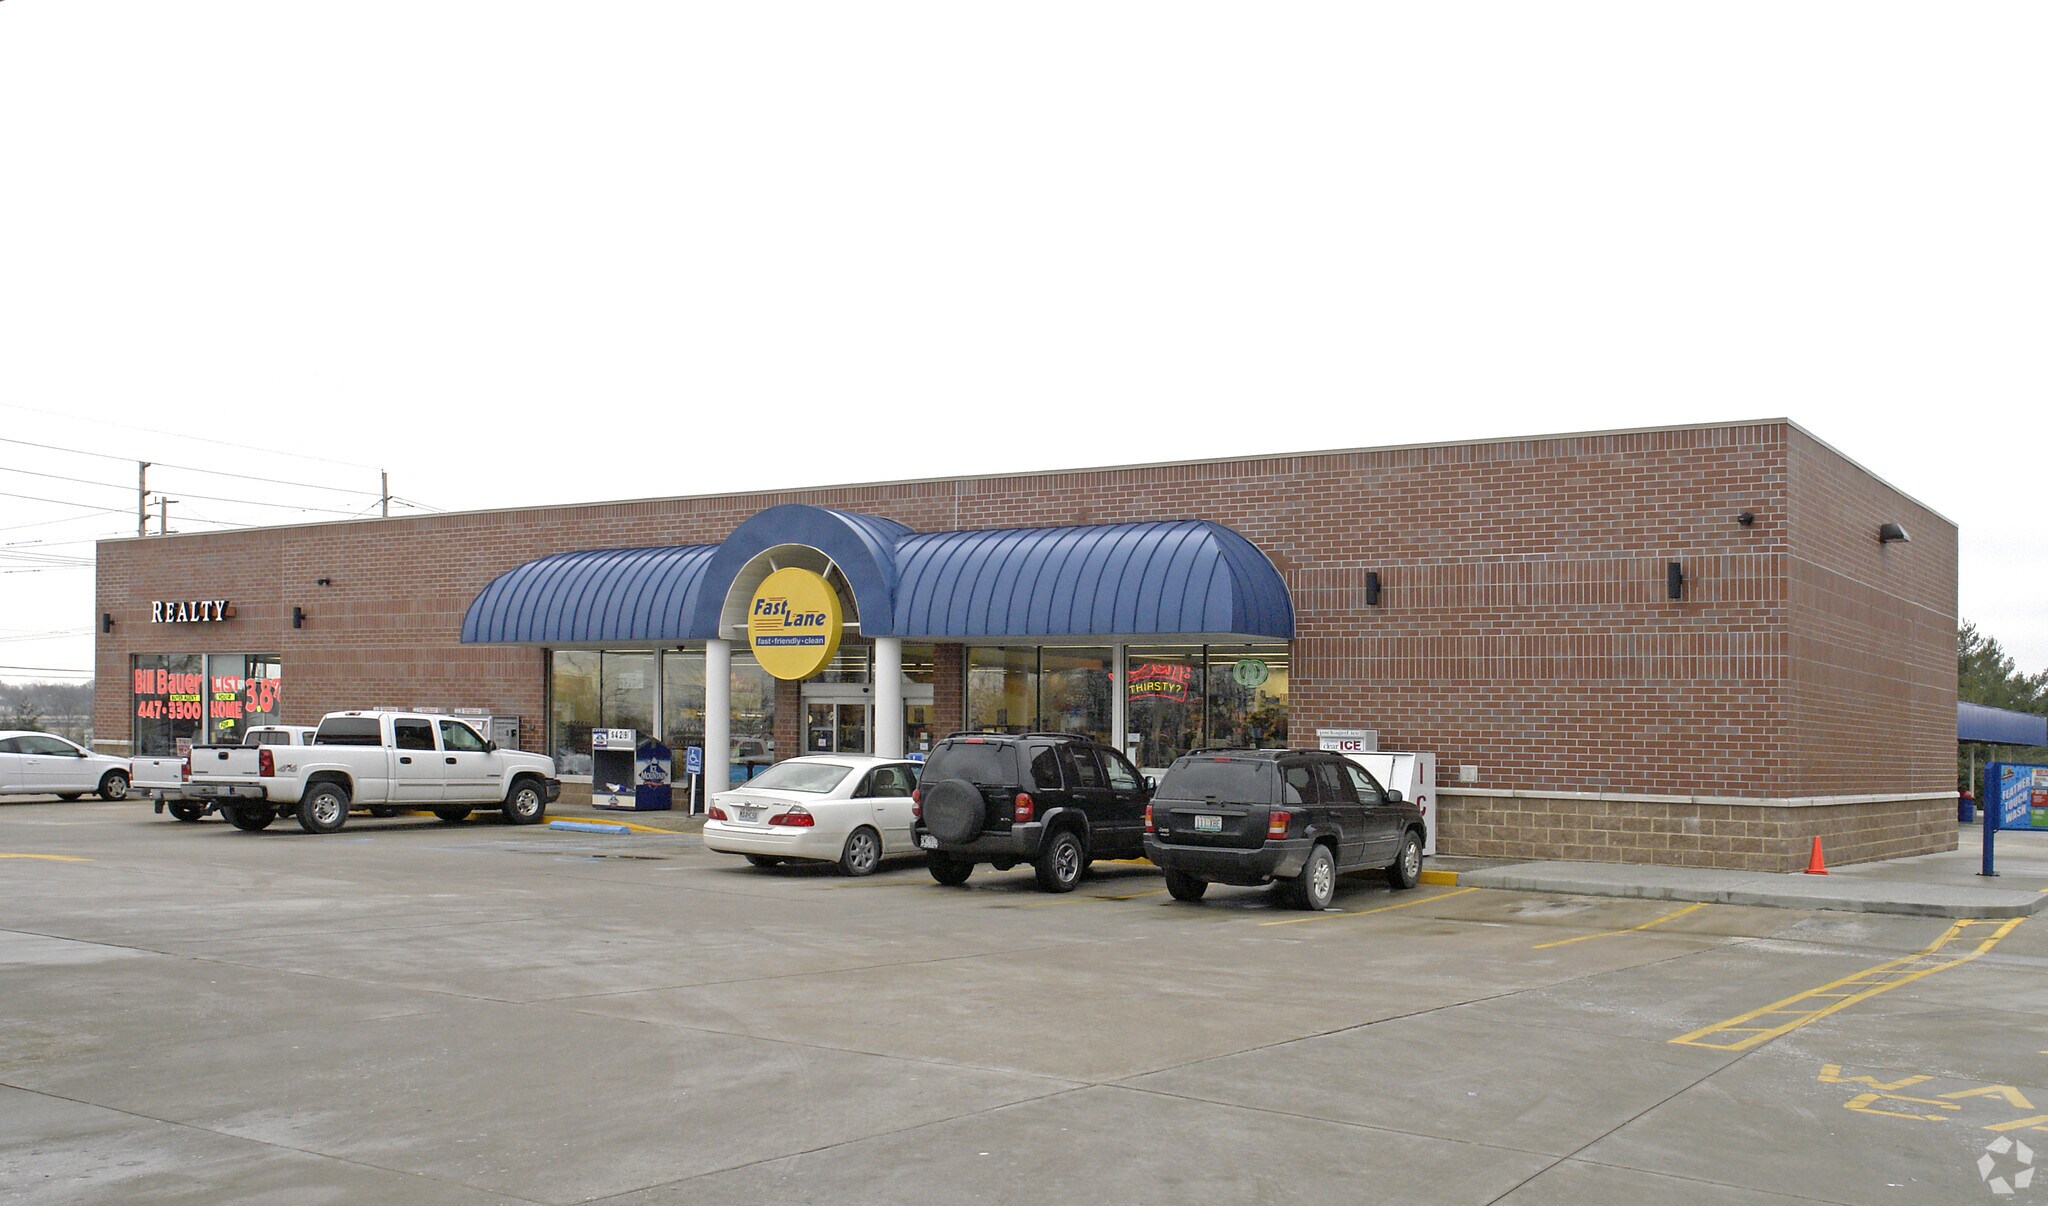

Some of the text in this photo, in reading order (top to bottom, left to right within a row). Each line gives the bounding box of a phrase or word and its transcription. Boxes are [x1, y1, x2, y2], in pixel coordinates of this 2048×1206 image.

[151, 600, 226, 623] REALTY
[754, 599, 788, 615] Fast
[783, 610, 826, 627] Lane
[135, 669, 202, 694] Bill Bauer
[211, 676, 240, 693] LIST
[1129, 681, 1182, 694] THIRSTY?
[210, 701, 242, 719] HOME
[1339, 741, 1361, 750] ICE
[2002, 777, 2031, 800] FEATHER
[2005, 790, 2028, 812] TOUCH
[2005, 803, 2027, 823] WASH
